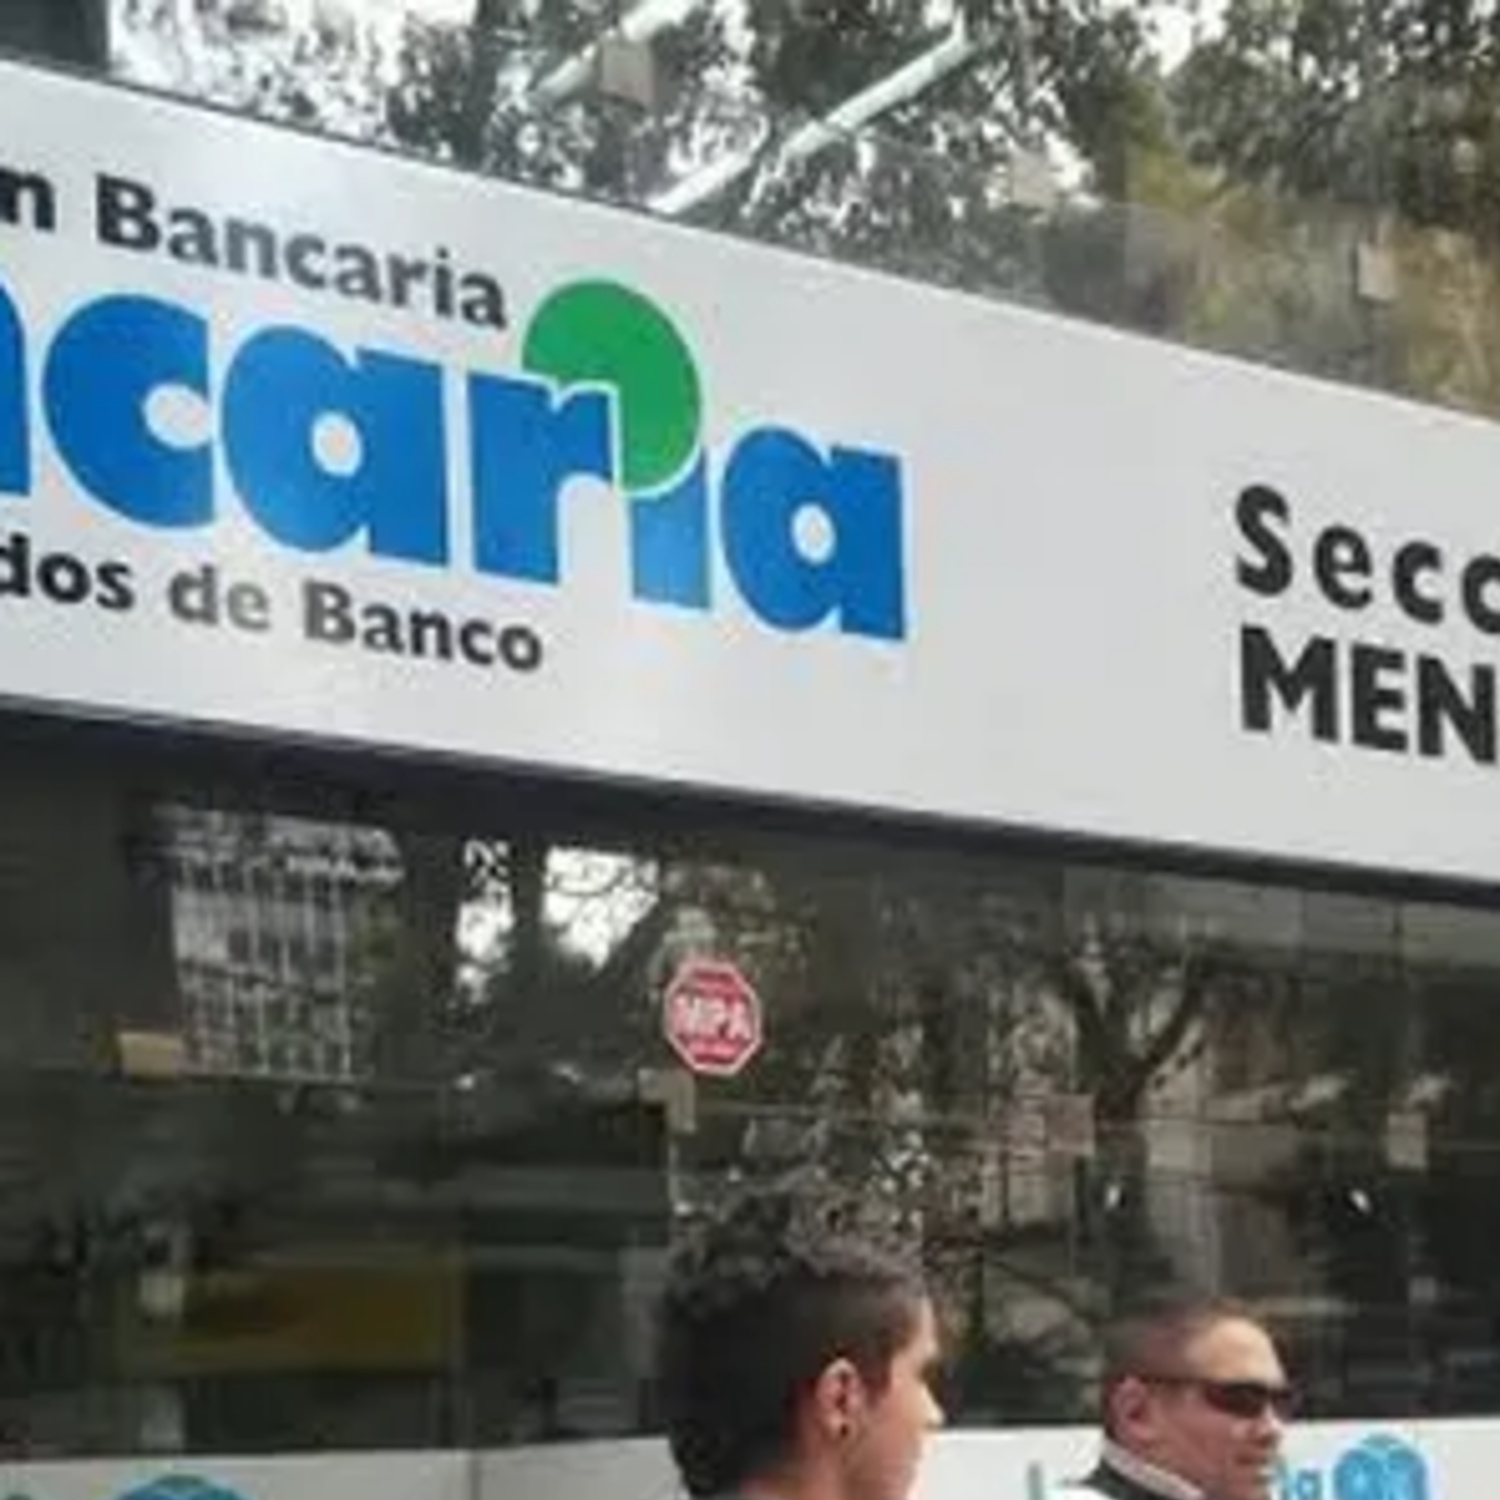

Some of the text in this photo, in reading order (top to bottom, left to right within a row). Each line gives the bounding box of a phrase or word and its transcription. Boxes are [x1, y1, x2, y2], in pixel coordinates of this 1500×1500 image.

[95, 171, 508, 330] Bancaria
[169, 564, 271, 631] de
[302, 578, 542, 672] Banco
